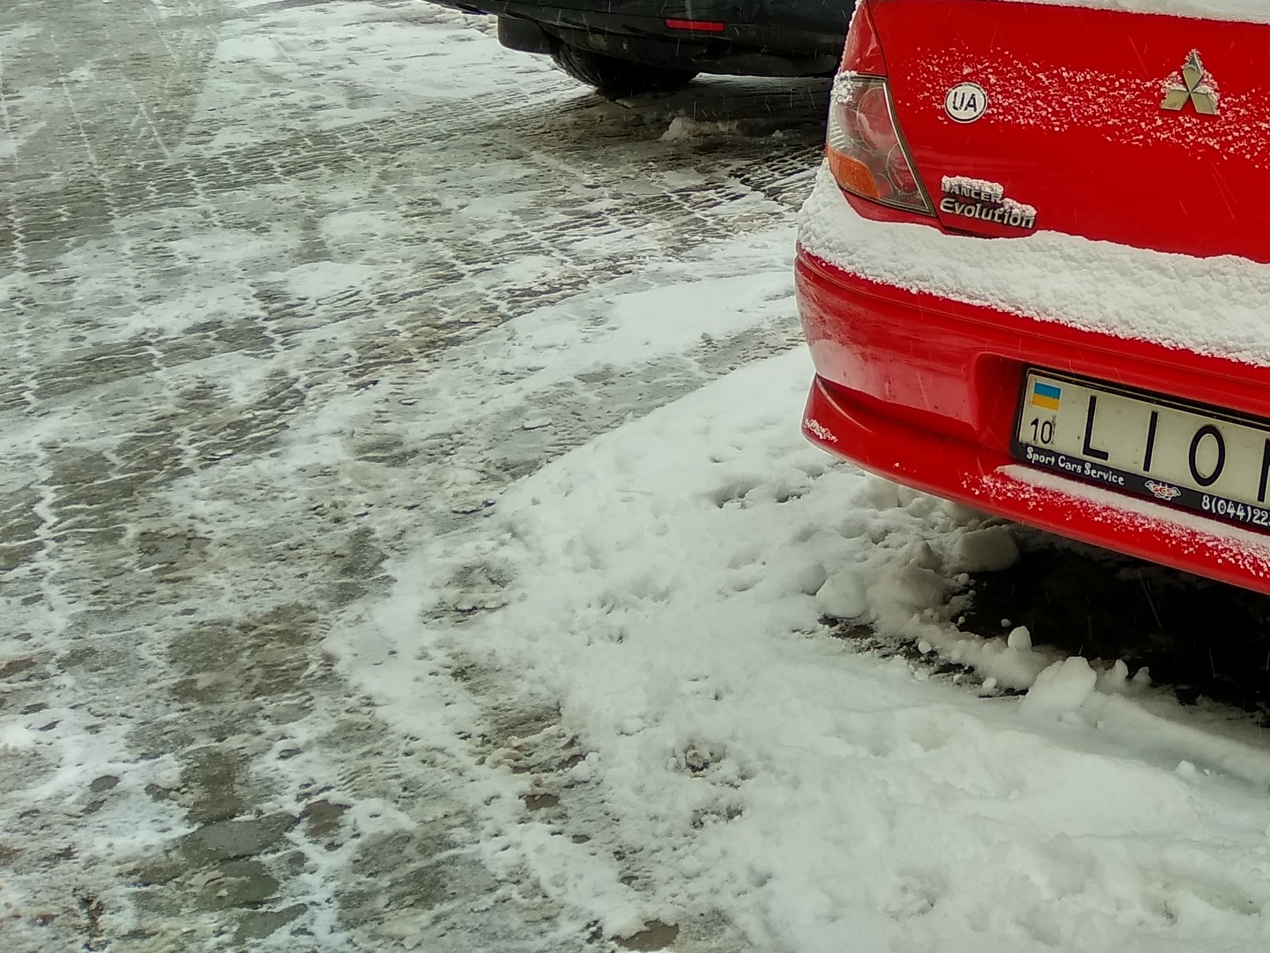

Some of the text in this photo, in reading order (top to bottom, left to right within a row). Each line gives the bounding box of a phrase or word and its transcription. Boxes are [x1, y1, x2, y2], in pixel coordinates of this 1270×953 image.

[952, 91, 978, 113] UA
[940, 197, 1036, 229] Evolution
[1030, 417, 1054, 445] 10
[1026, 446, 1125, 486] Sport Cars Service
